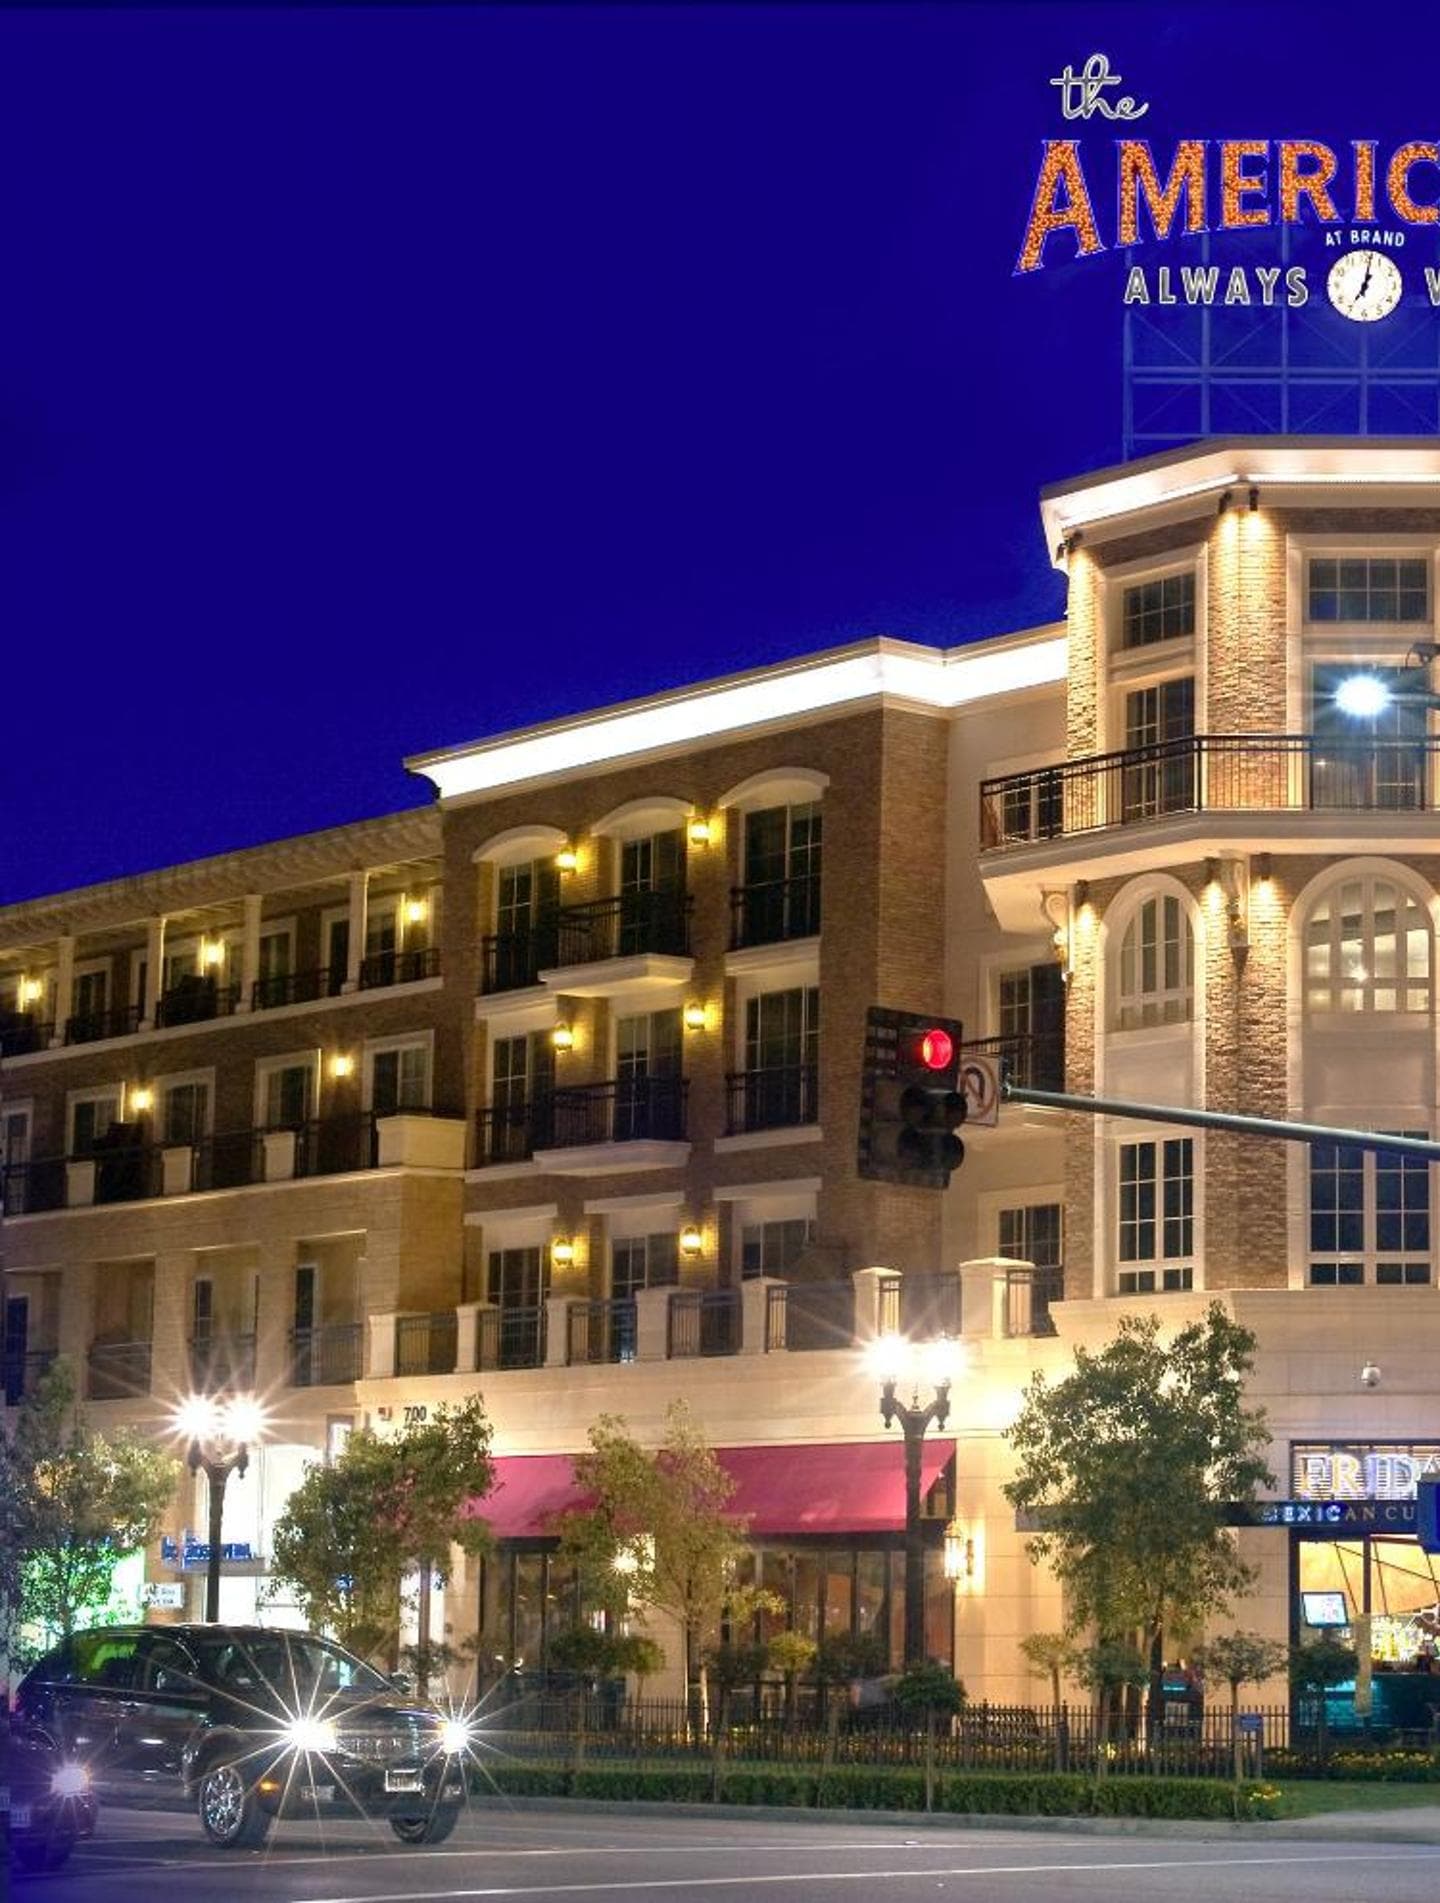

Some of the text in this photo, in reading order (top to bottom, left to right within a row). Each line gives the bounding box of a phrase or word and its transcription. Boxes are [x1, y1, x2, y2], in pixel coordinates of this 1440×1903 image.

[1050, 53, 1150, 121] the
[1325, 229, 1405, 247] AT BRAND
[1123, 266, 1309, 307] ALWAYS
